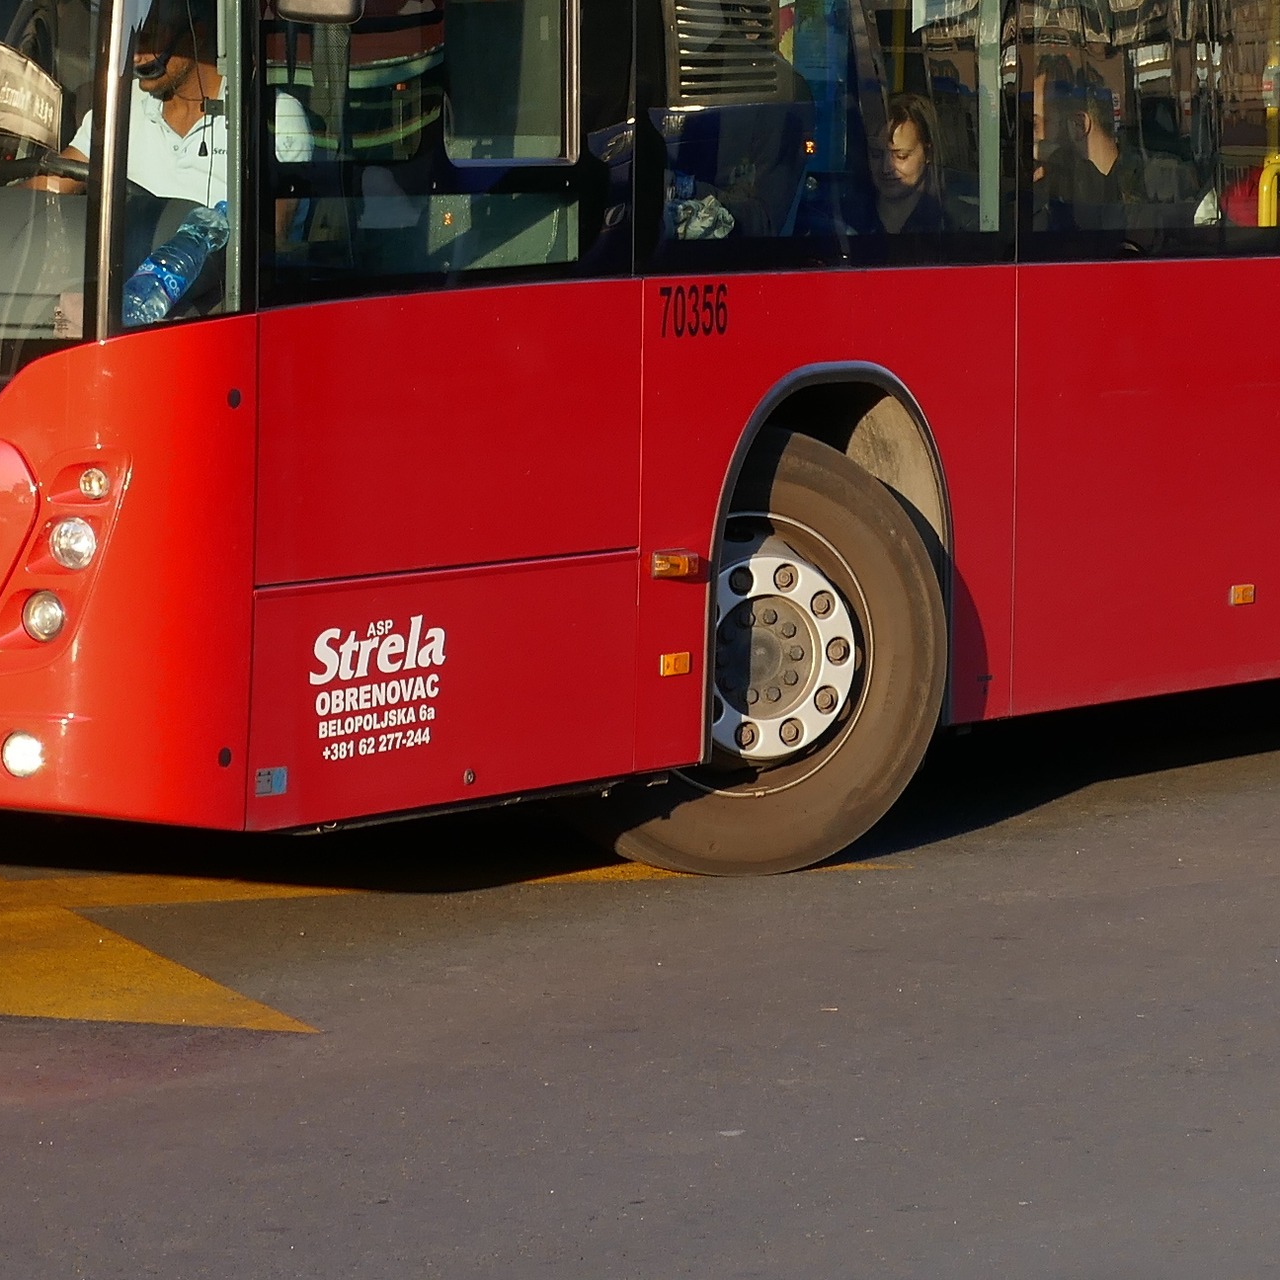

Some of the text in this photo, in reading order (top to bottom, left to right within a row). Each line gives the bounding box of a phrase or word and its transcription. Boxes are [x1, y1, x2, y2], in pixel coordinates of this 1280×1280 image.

[659, 283, 729, 338] 70356
[366, 619, 394, 638] ASP
[309, 614, 447, 686] Strela
[315, 673, 440, 717] OBRENOVAC
[318, 704, 436, 739] BELOPOLJSKA 6a
[322, 726, 432, 761] +381 62 277-244
